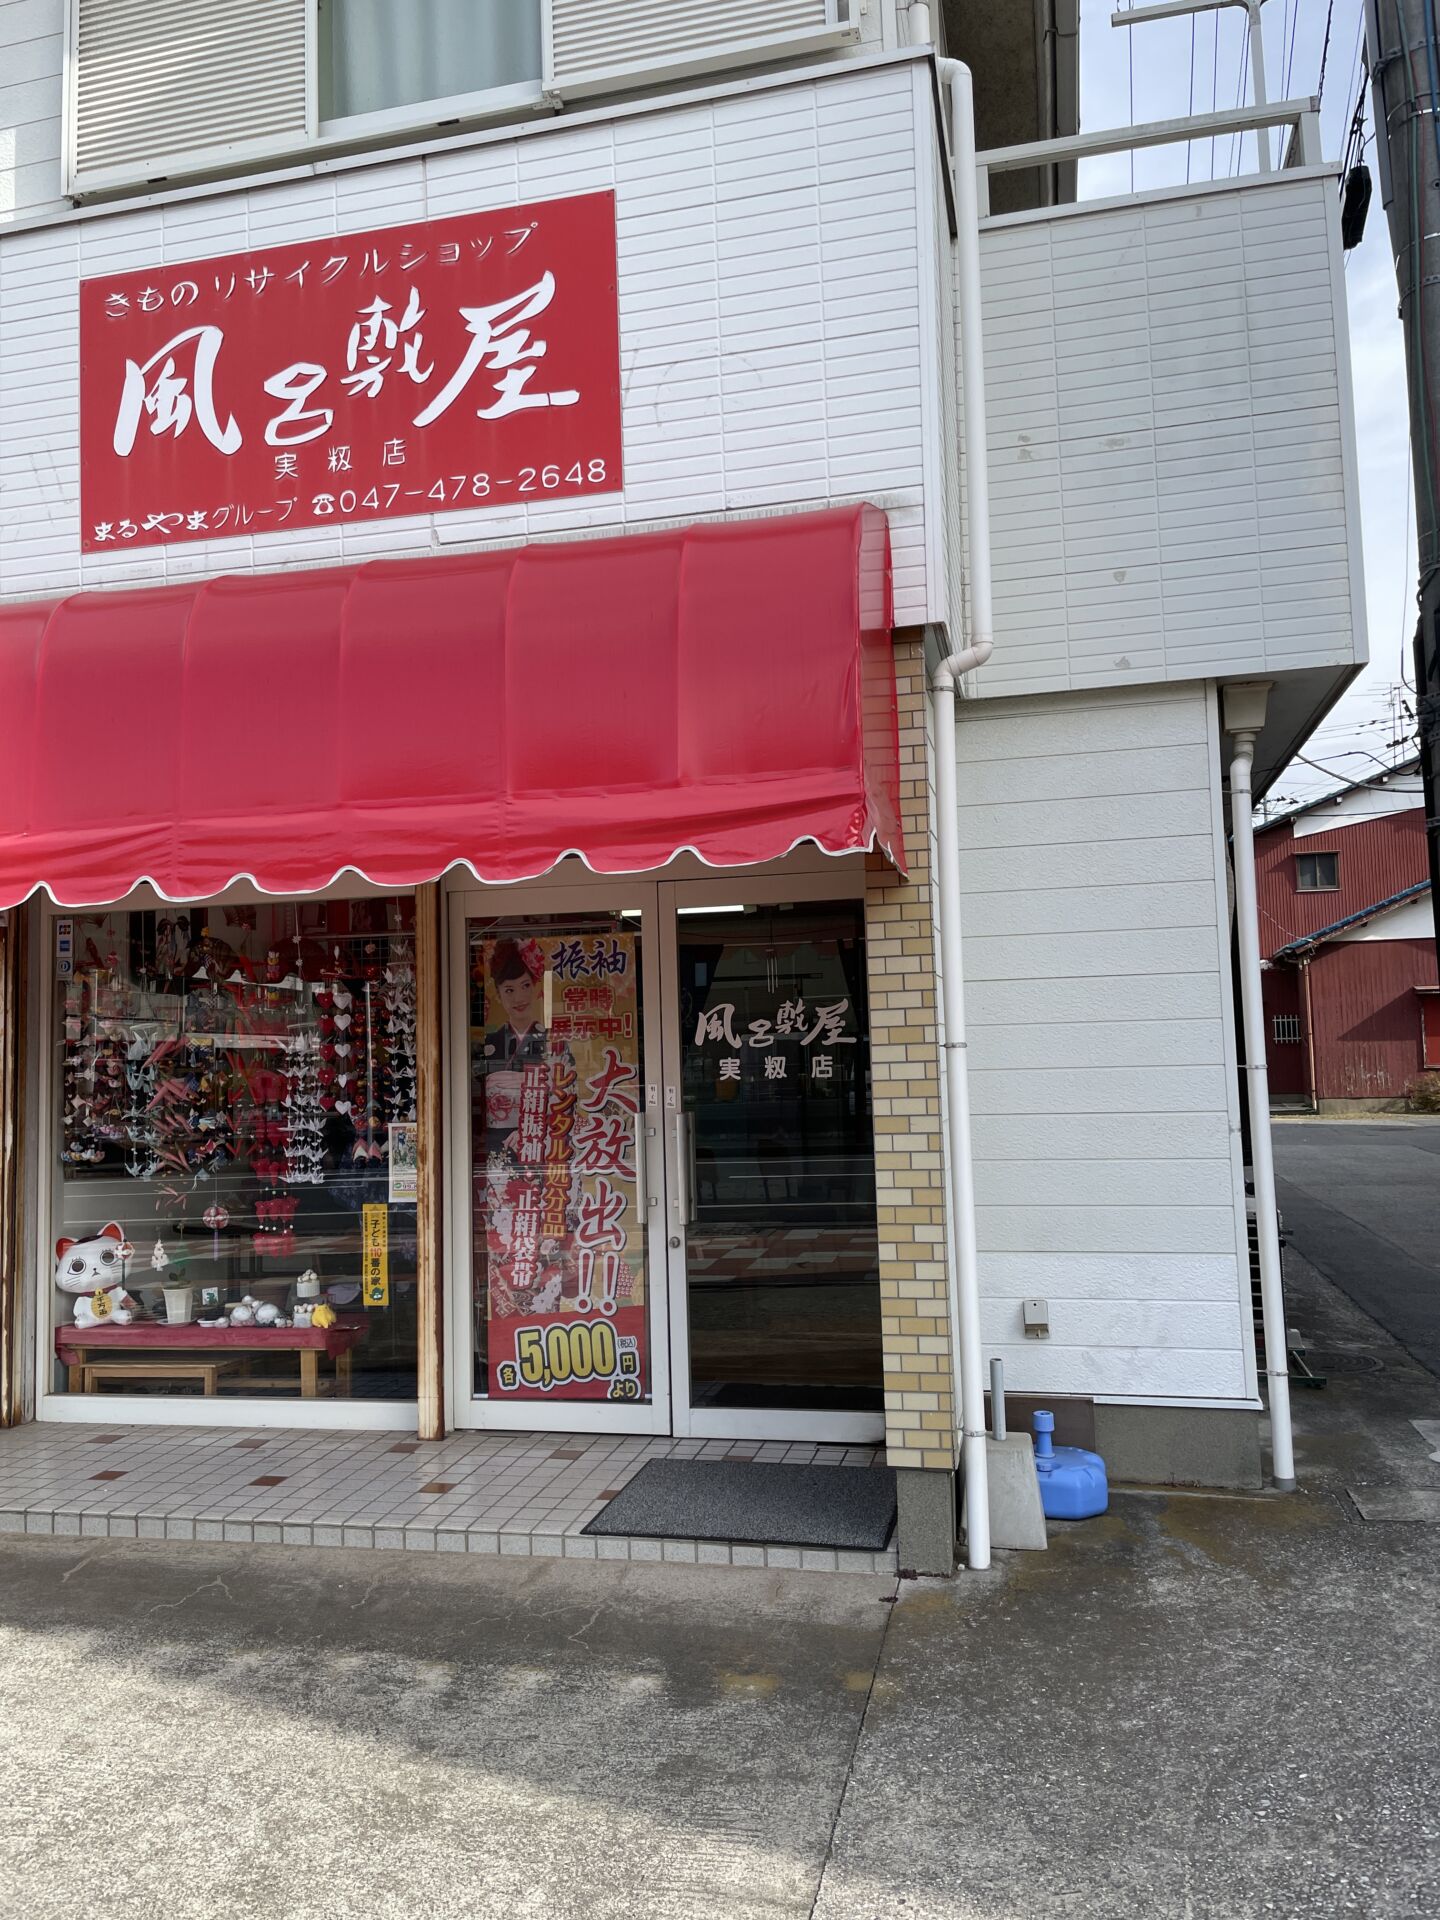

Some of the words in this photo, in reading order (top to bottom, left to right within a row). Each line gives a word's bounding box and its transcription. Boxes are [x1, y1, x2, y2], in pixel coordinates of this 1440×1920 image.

[105, 221, 539, 318] きものリサイクルショップ
[113, 270, 580, 457] 風呂敷屋
[273, 437, 408, 481] 実籾店
[93, 496, 298, 542] まるやまグループ
[339, 458, 607, 513] 047-478-2648
[551, 940, 628, 980] 振袖
[551, 1013, 632, 1041] 展示中!
[564, 986, 613, 1012] 常時
[694, 998, 857, 1049] 風呂敷屋
[719, 1054, 833, 1081] 実籾店
[543, 1063, 577, 1239] レンタル処分品
[574, 1049, 639, 1313] 大放出!!
[370, 1219, 382, 1286] 子ども110番の家
[501, 1366, 515, 1385] 各
[518, 1323, 615, 1385] 5,000
[621, 1354, 635, 1372] 円
[612, 1380, 637, 1398] より
